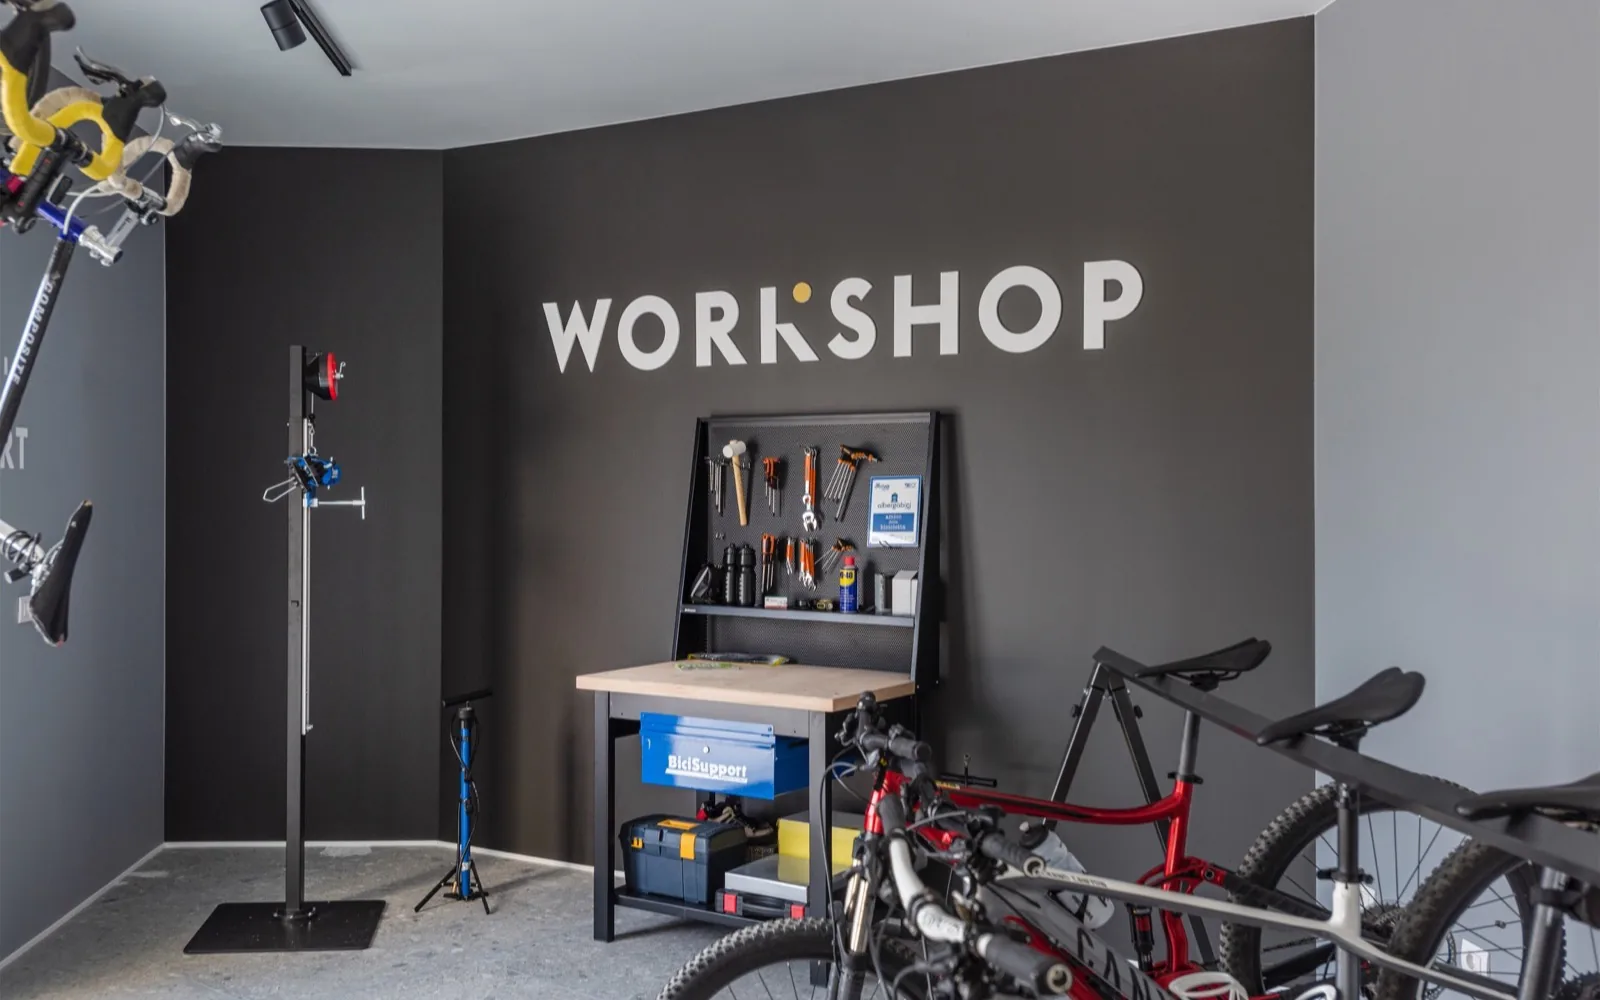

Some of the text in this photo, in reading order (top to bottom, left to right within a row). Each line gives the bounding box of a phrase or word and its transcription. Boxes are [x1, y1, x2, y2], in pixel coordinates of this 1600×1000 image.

[12, 281, 53, 384] COMPOSITE
[543, 260, 1143, 374] WORKSHOP
[668, 755, 747, 778] BiciSupport
[1077, 927, 1169, 1000] CAN
